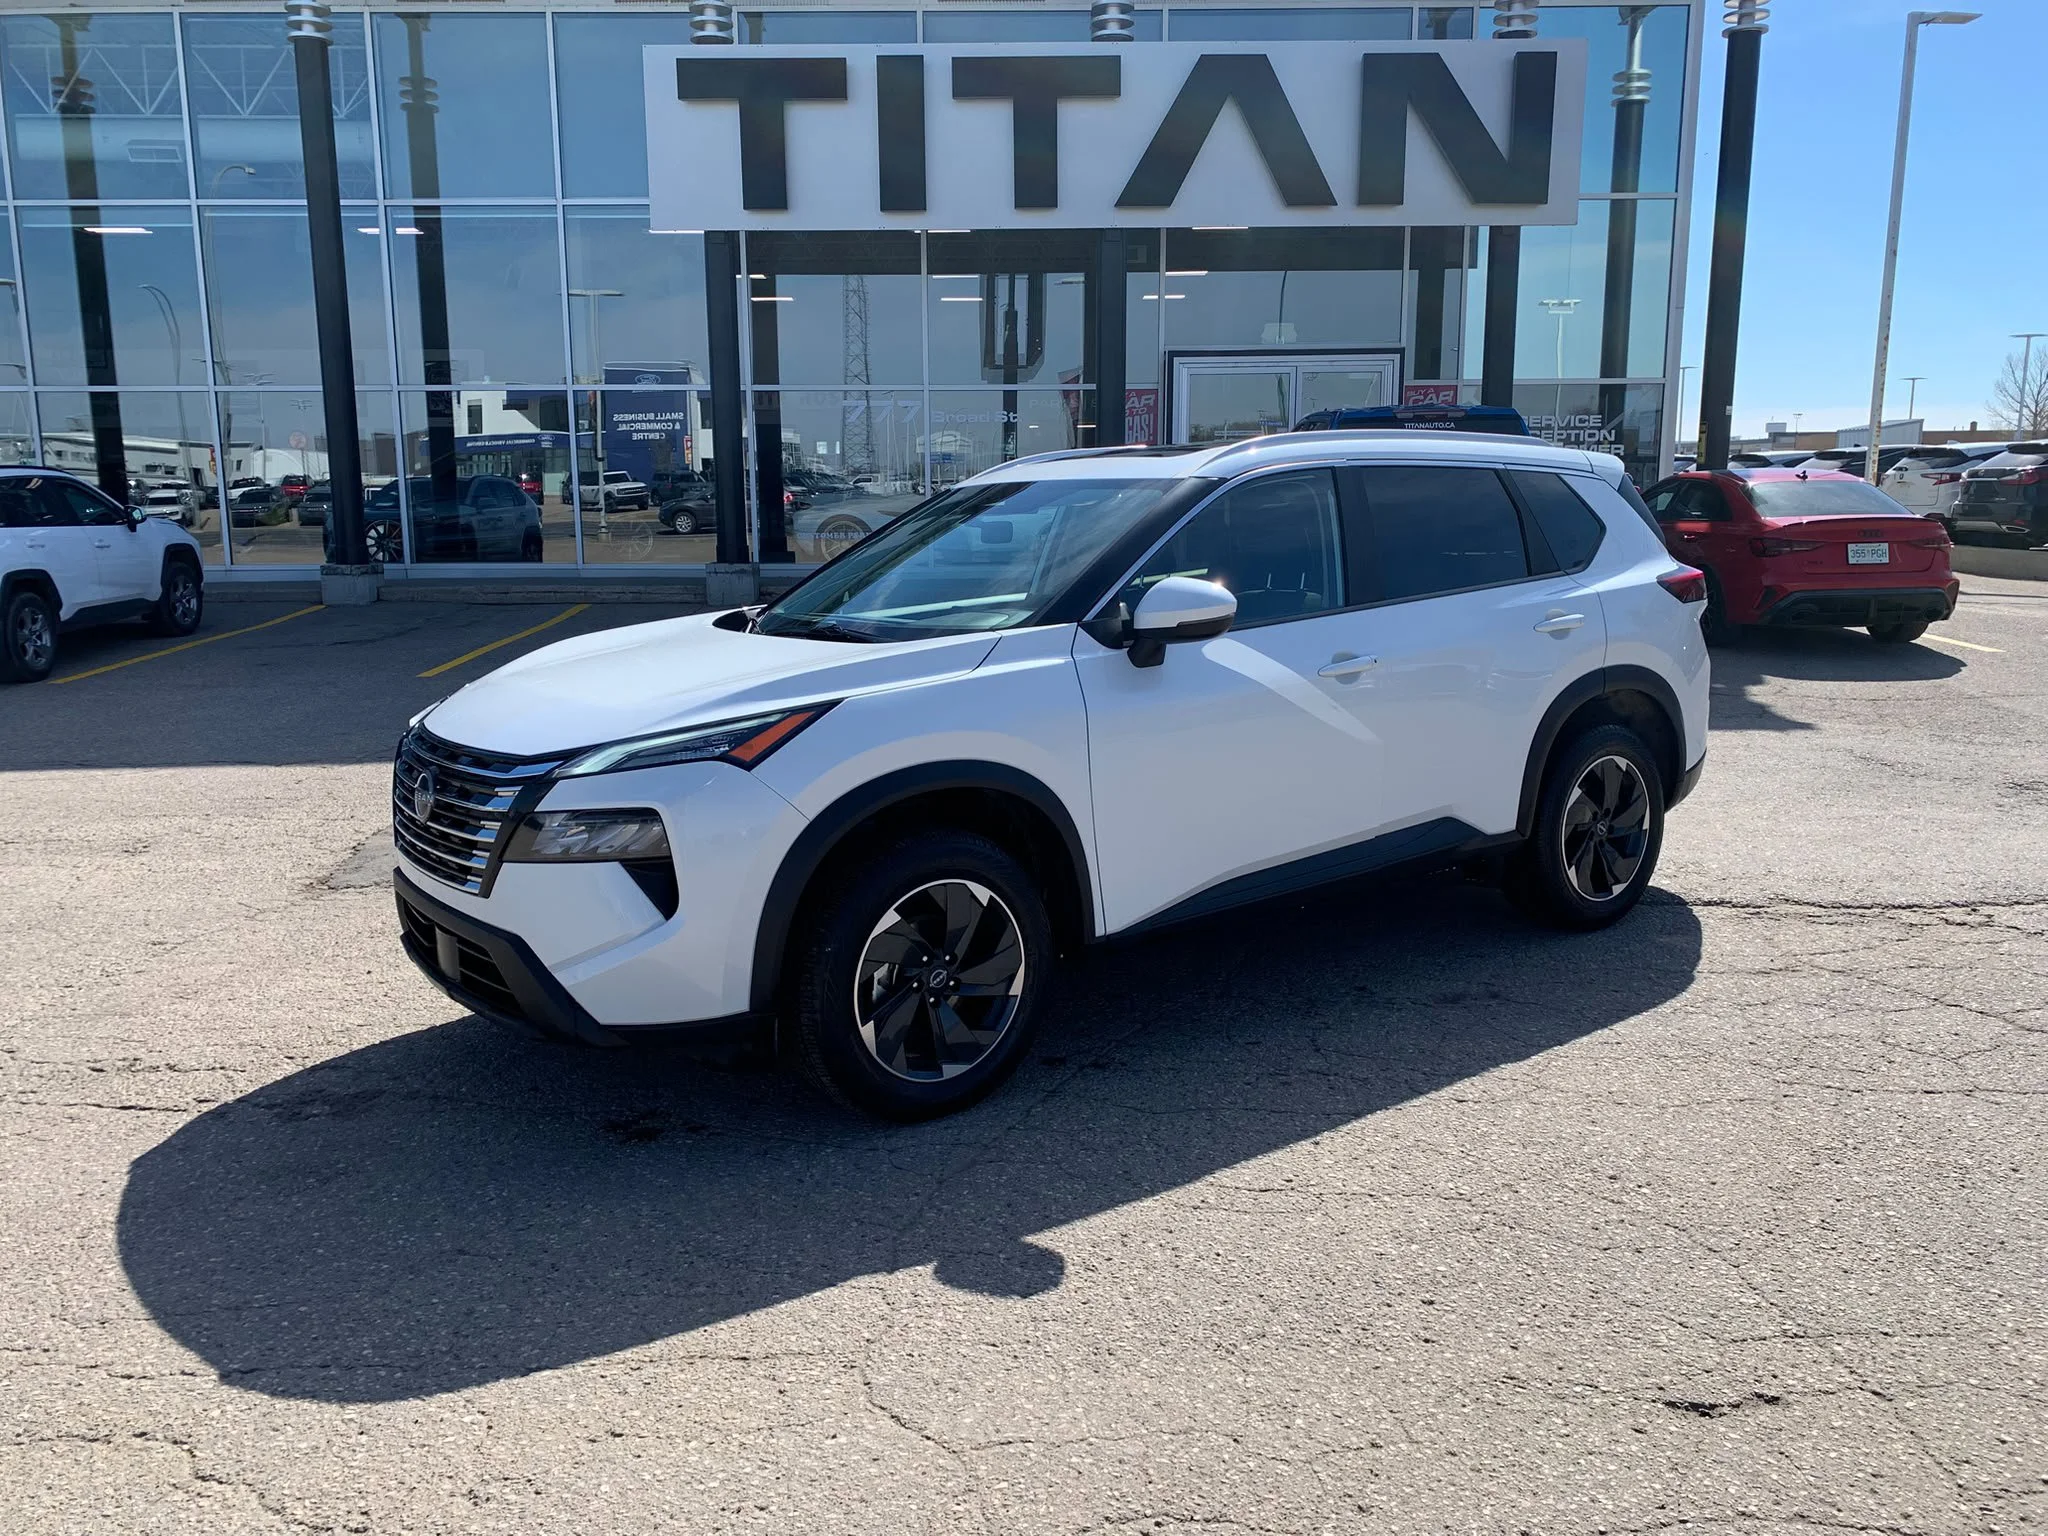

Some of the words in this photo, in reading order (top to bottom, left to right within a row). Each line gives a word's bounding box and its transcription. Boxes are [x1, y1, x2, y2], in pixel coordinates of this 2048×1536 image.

[676, 50, 1558, 212] TITAN
[1408, 390, 1454, 407] CAR
[932, 410, 991, 423] Broad
